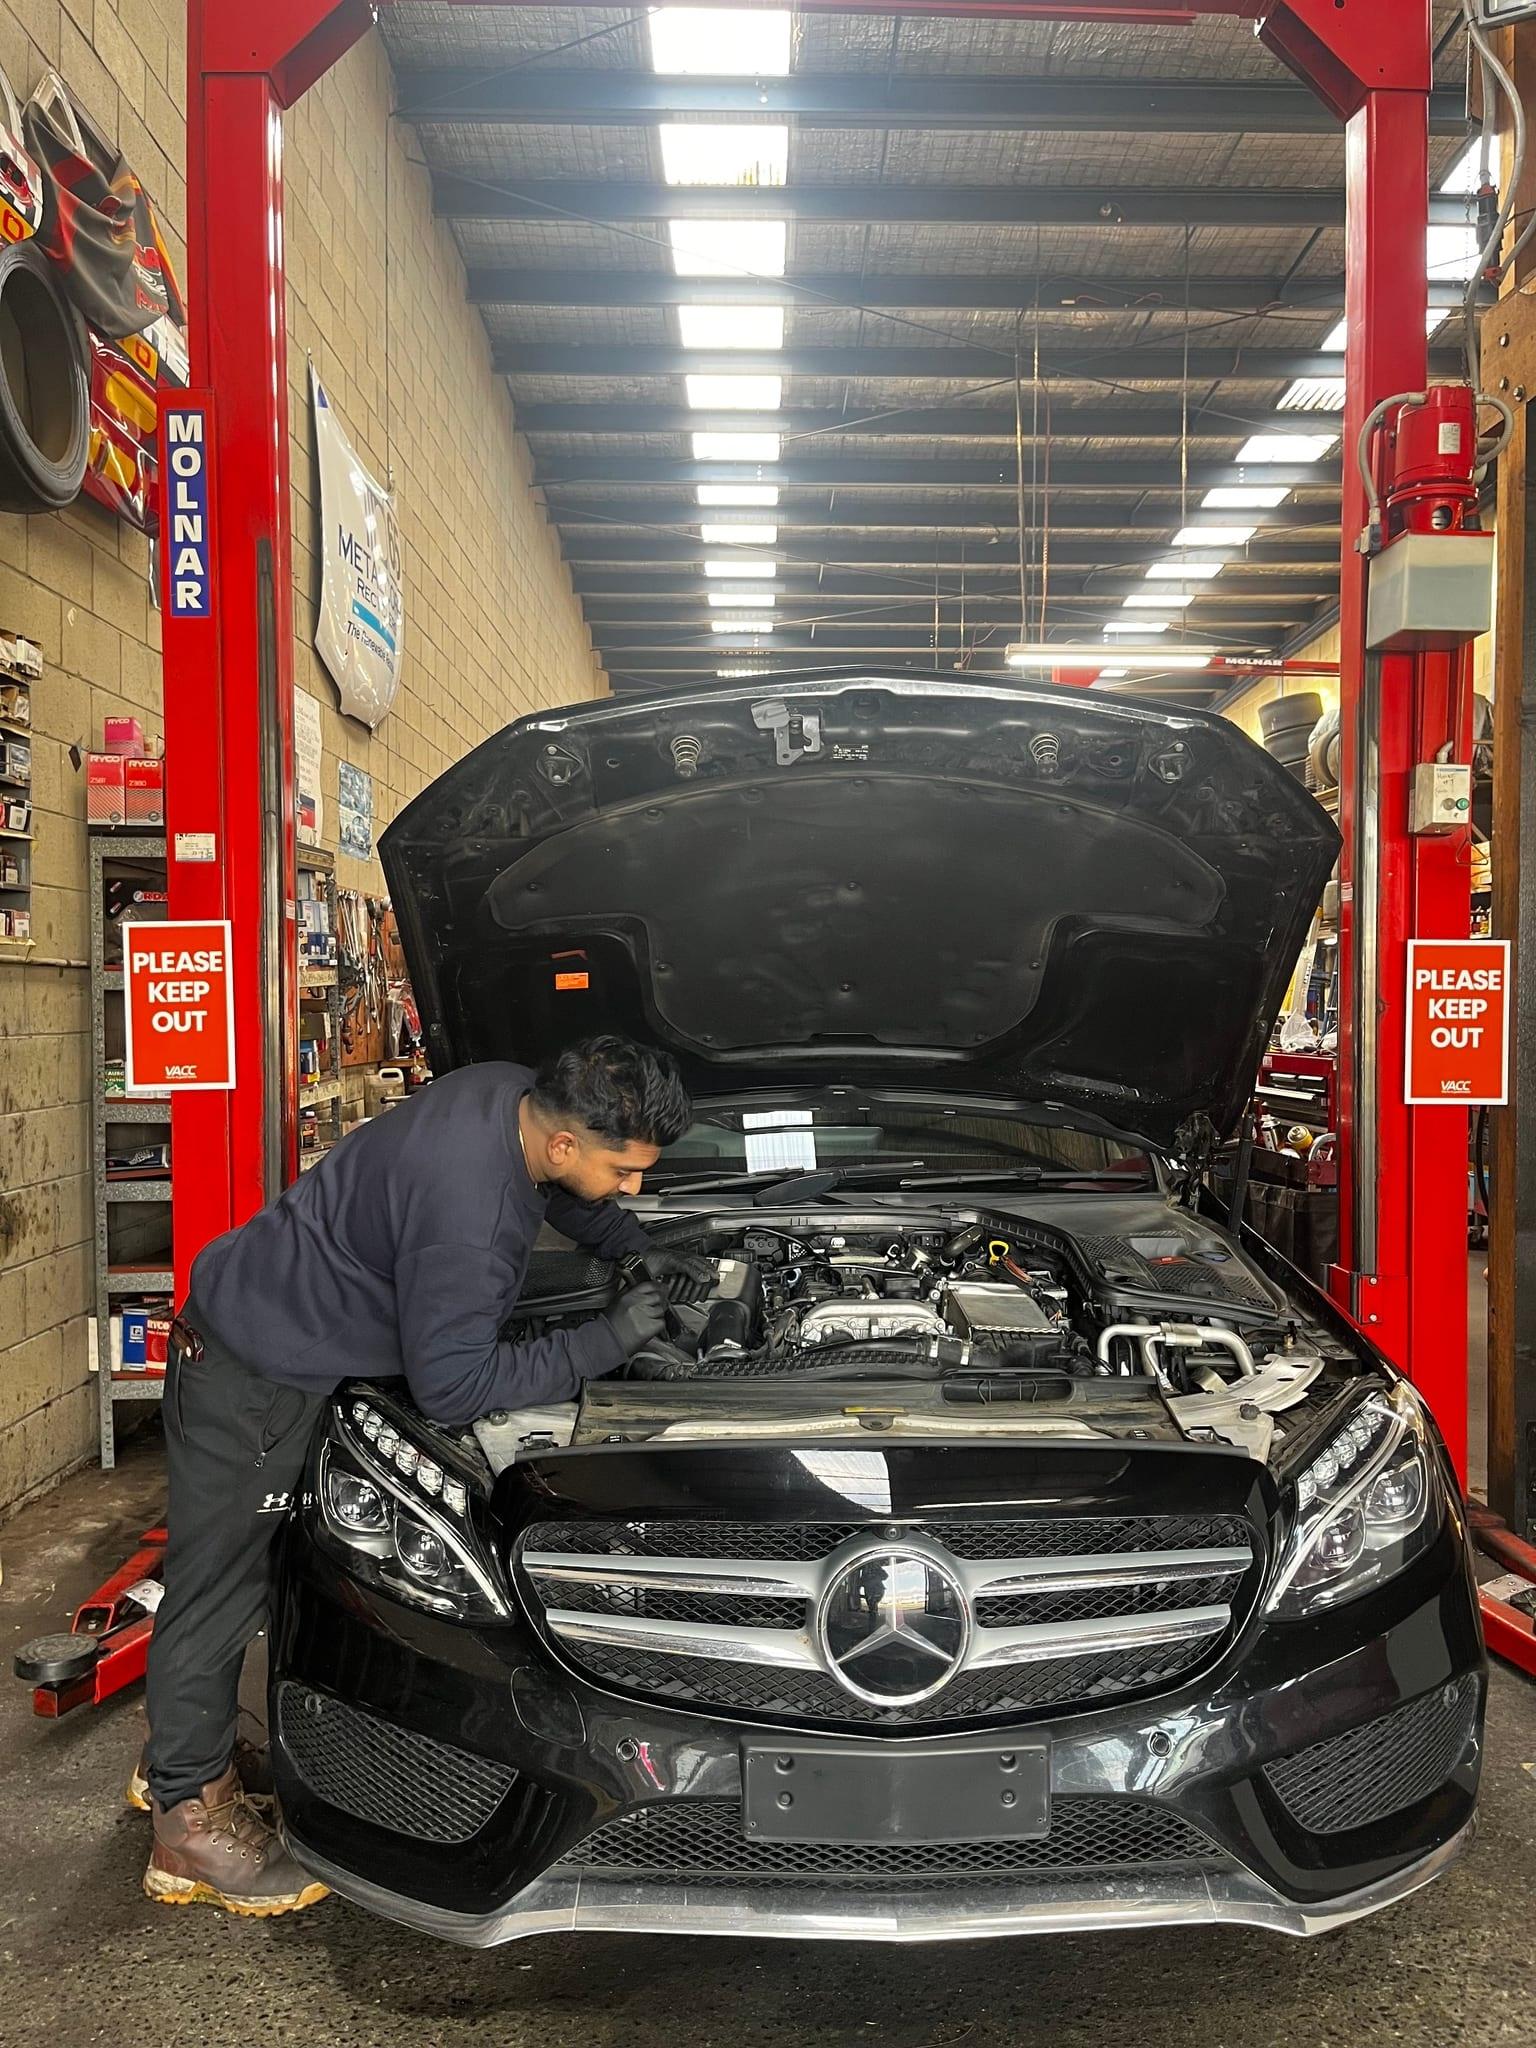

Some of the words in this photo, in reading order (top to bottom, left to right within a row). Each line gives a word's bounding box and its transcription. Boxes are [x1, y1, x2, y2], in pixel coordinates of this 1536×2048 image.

[168, 414, 204, 609] MOLNAR
[1225, 657, 1283, 666] MOLNAR
[90, 755, 120, 763] RYCO
[128, 760, 159, 768] RYCO
[133, 951, 223, 974] PLEASE
[1415, 969, 1502, 990] PLEASE
[148, 981, 210, 1003] KEEP
[1428, 998, 1488, 1019] KEEP
[151, 1010, 207, 1032] OUT
[1430, 1026, 1484, 1048] OUT
[165, 1065, 197, 1076] VACC
[1441, 1080, 1472, 1091] VACC
